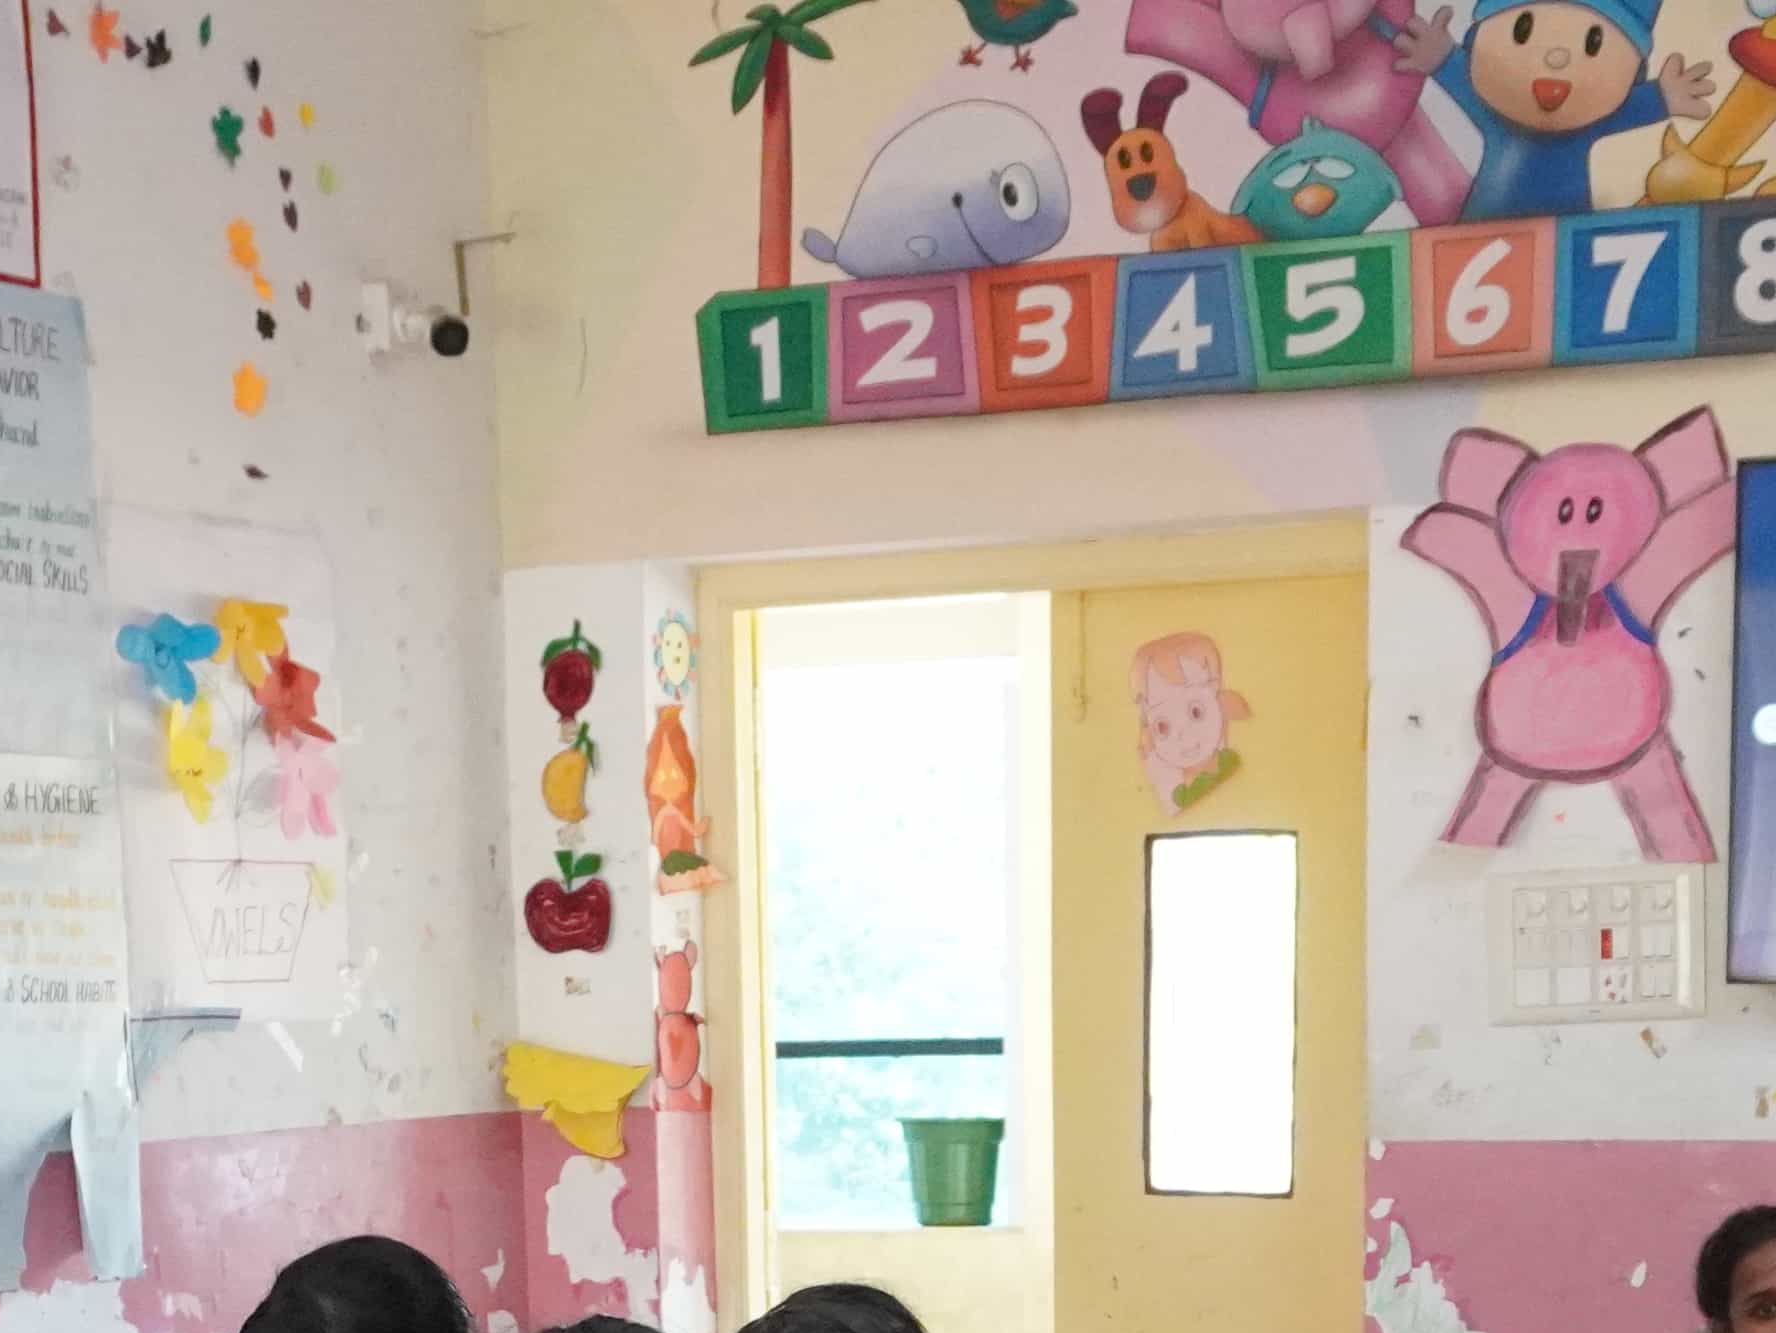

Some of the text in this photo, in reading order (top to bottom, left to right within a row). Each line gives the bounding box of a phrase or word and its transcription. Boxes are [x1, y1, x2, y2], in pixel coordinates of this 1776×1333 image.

[750, 319, 780, 402] 1
[858, 302, 937, 388] 2
[1010, 284, 1071, 375] 3
[1135, 275, 1213, 370] 4
[1284, 259, 1365, 355] 5
[1445, 239, 1512, 345] 6
[1591, 231, 1667, 333] 7
[25, 782, 106, 816] HYGIENE
[21, 976, 70, 1004] SCHOOL
